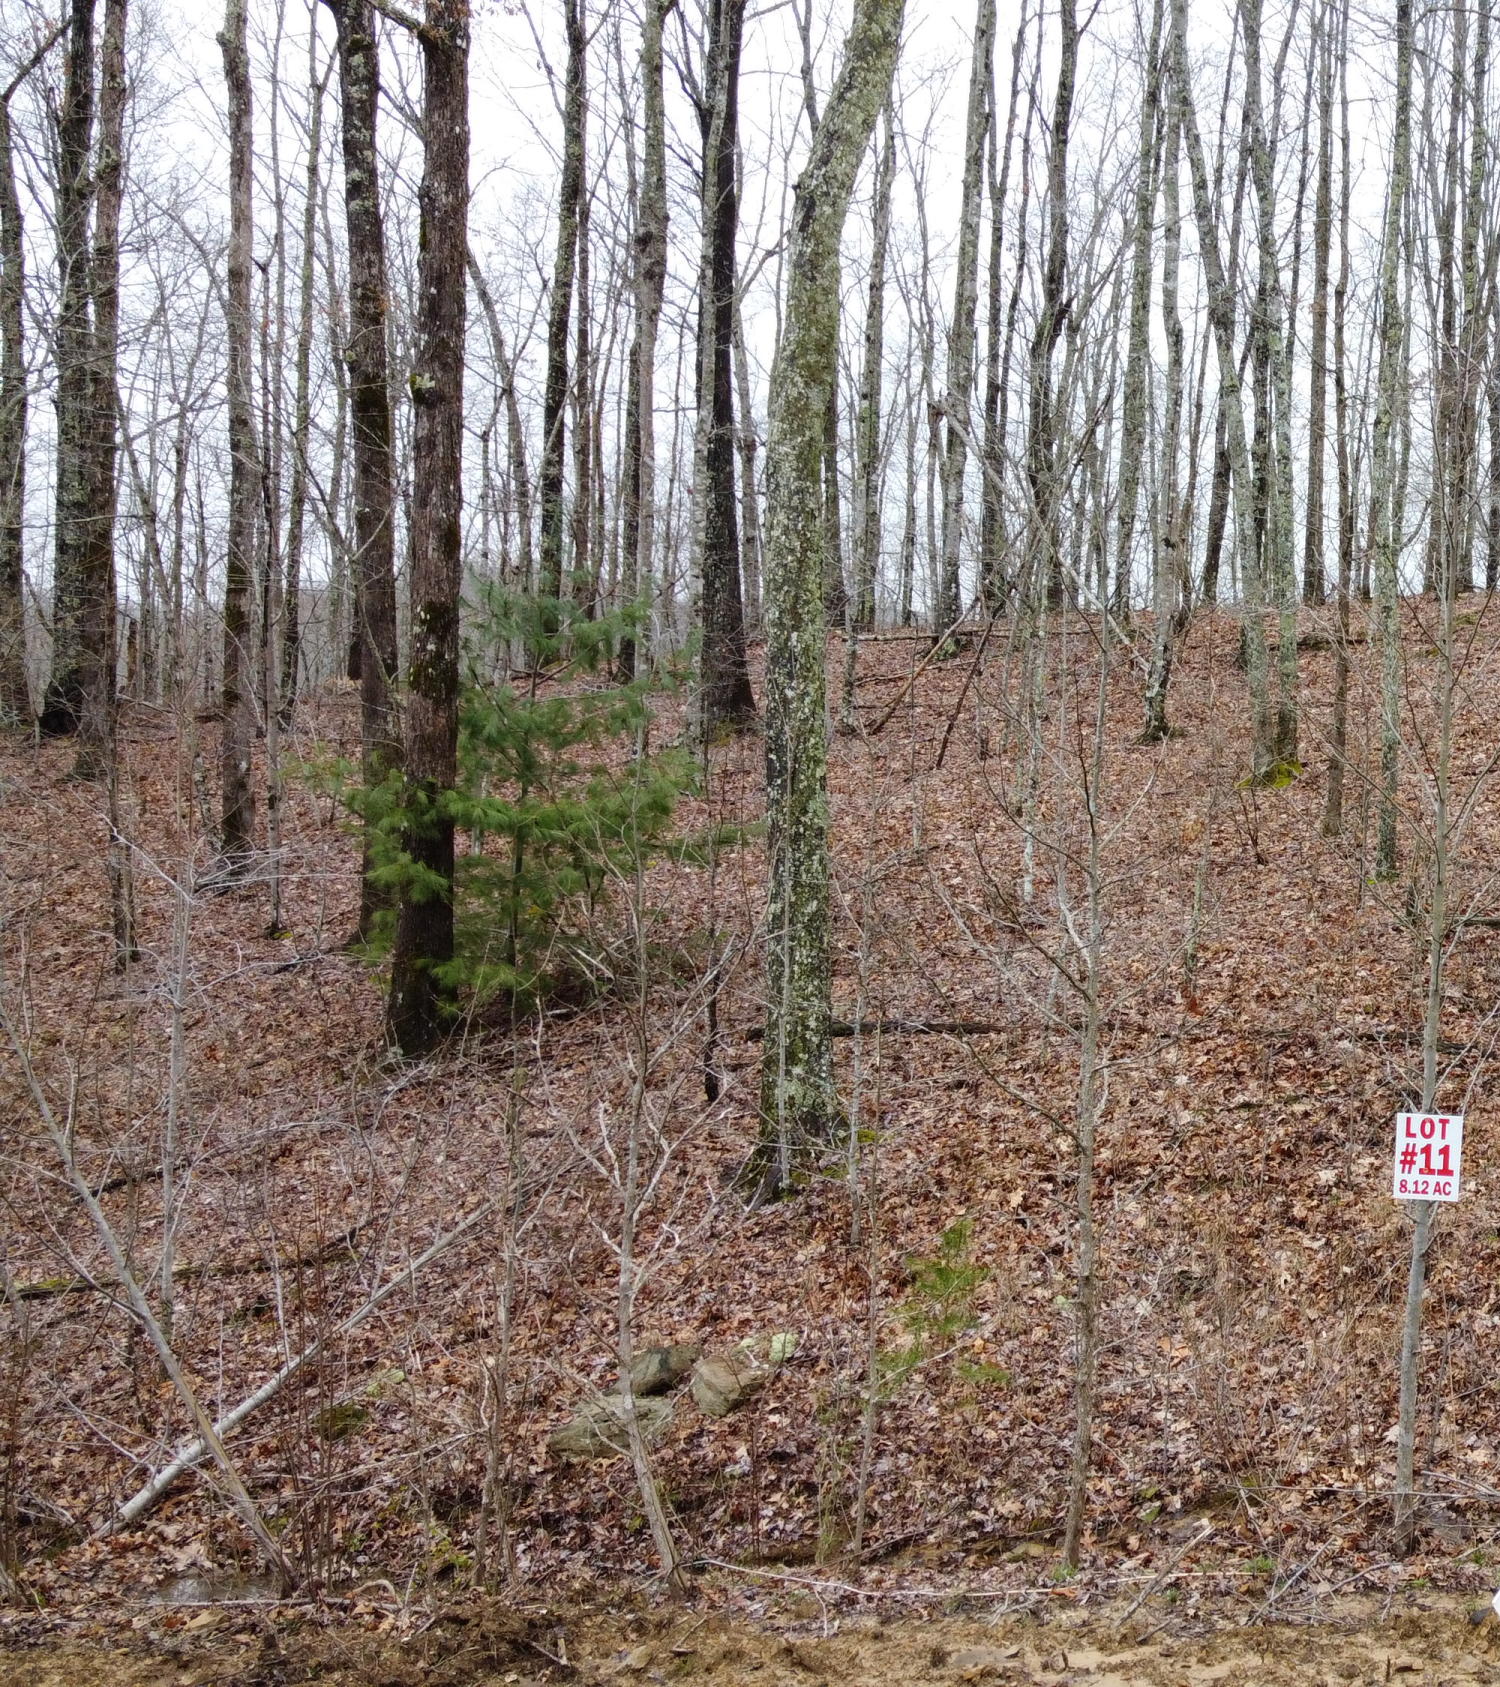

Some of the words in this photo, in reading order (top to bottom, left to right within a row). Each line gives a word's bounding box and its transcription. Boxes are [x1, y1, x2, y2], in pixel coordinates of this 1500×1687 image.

[1405, 1117, 1450, 1140] LOT
[1400, 1143, 1454, 1176] #11
[1399, 1179, 1429, 1195] 8.12
[1433, 1181, 1452, 1196] AC
